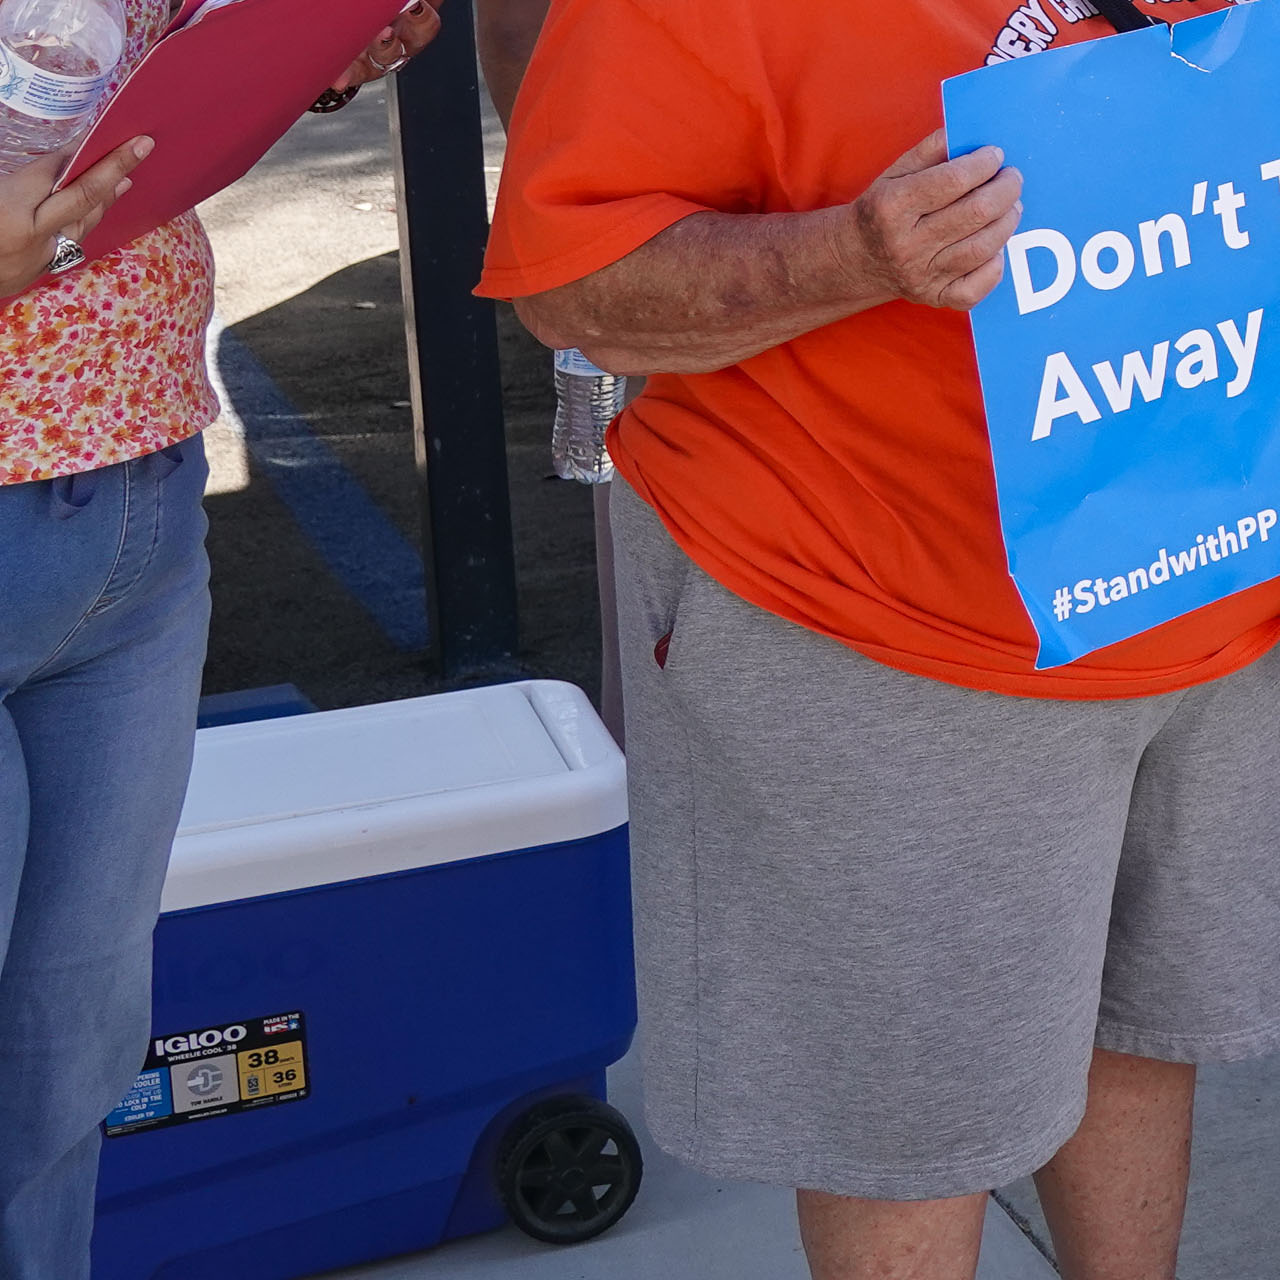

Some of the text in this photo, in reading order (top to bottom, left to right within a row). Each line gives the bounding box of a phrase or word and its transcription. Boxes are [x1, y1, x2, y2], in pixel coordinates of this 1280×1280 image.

[1007, 181, 1250, 315] Don't
[1031, 307, 1264, 442] Away
[1053, 508, 1278, 622] #StandwithPP
[155, 1025, 248, 1056] IGLOO
[167, 1051, 201, 1062] WHEELIE
[248, 1049, 279, 1068] 38
[273, 1069, 296, 1083] 36
